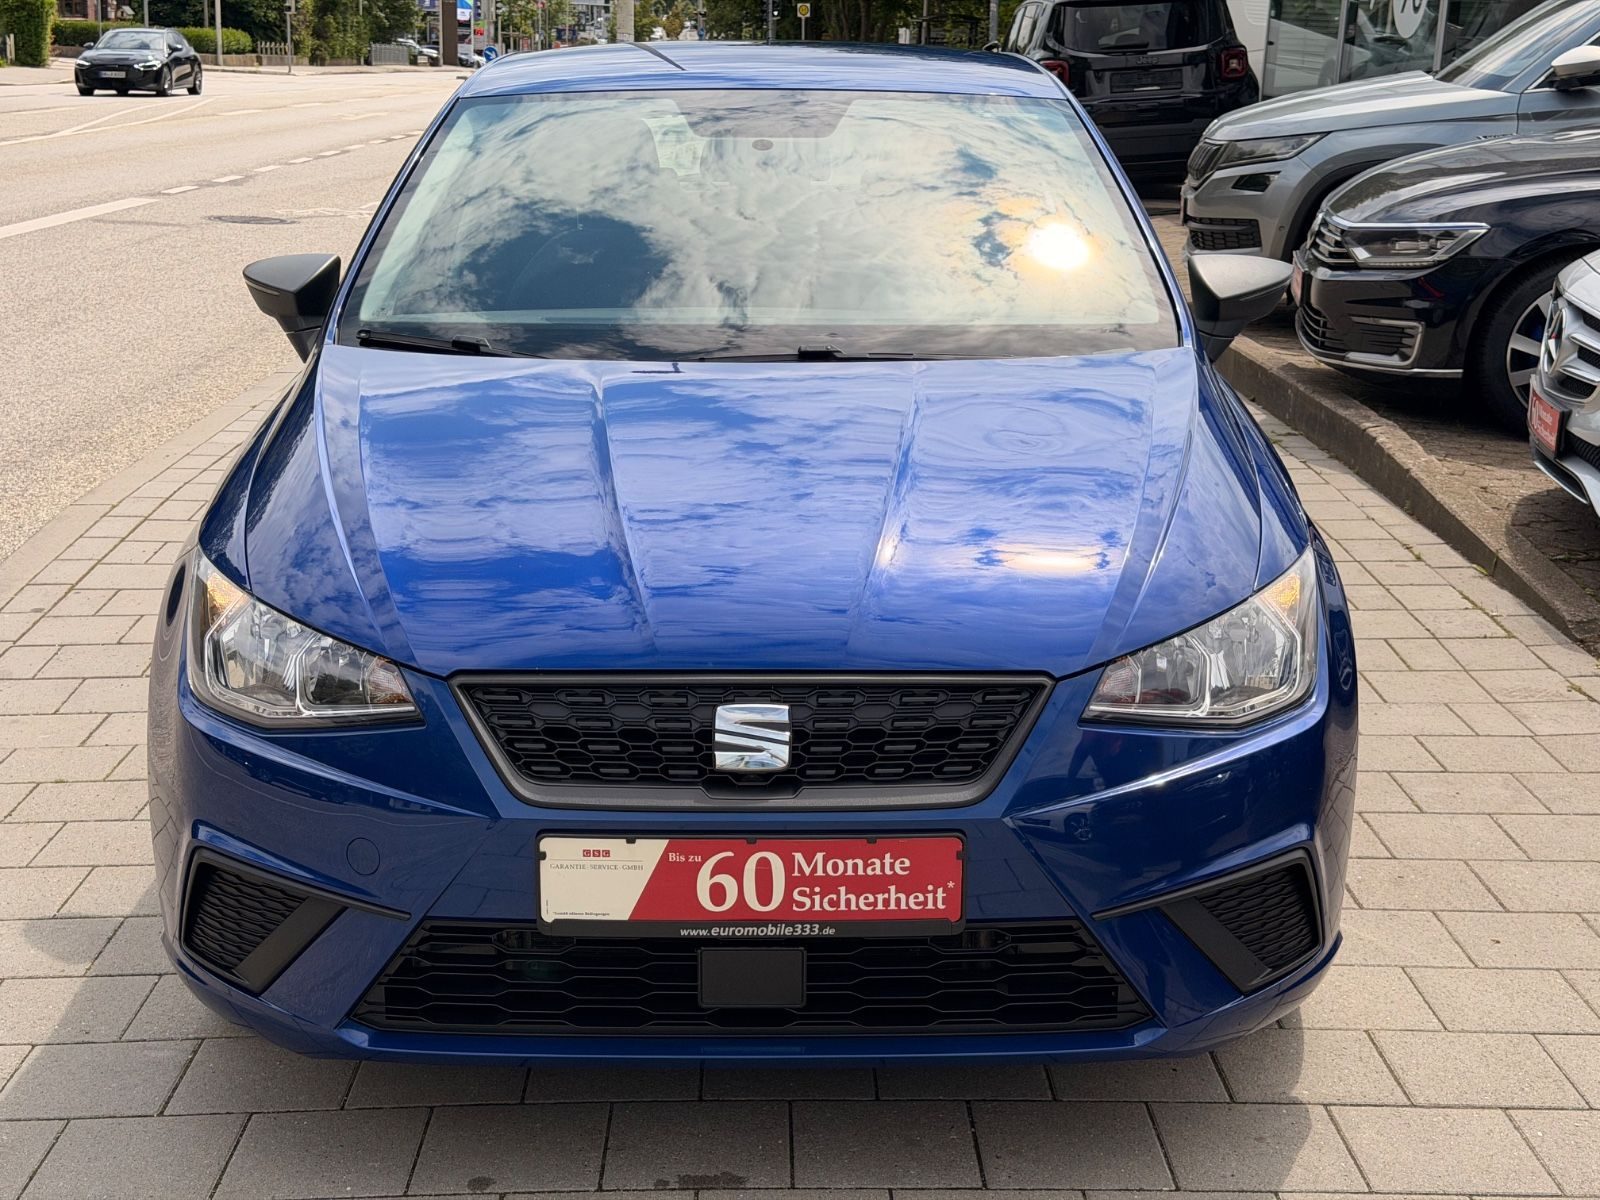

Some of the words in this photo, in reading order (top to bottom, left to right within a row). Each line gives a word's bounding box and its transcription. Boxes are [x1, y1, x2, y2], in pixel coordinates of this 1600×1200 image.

[1136, 56, 1160, 65] Jeep
[668, 852, 686, 862] Bis
[688, 854, 702, 863] zu
[791, 851, 911, 877] Monate
[696, 851, 786, 913] 60
[680, 923, 836, 937] www.euromobile333.de
